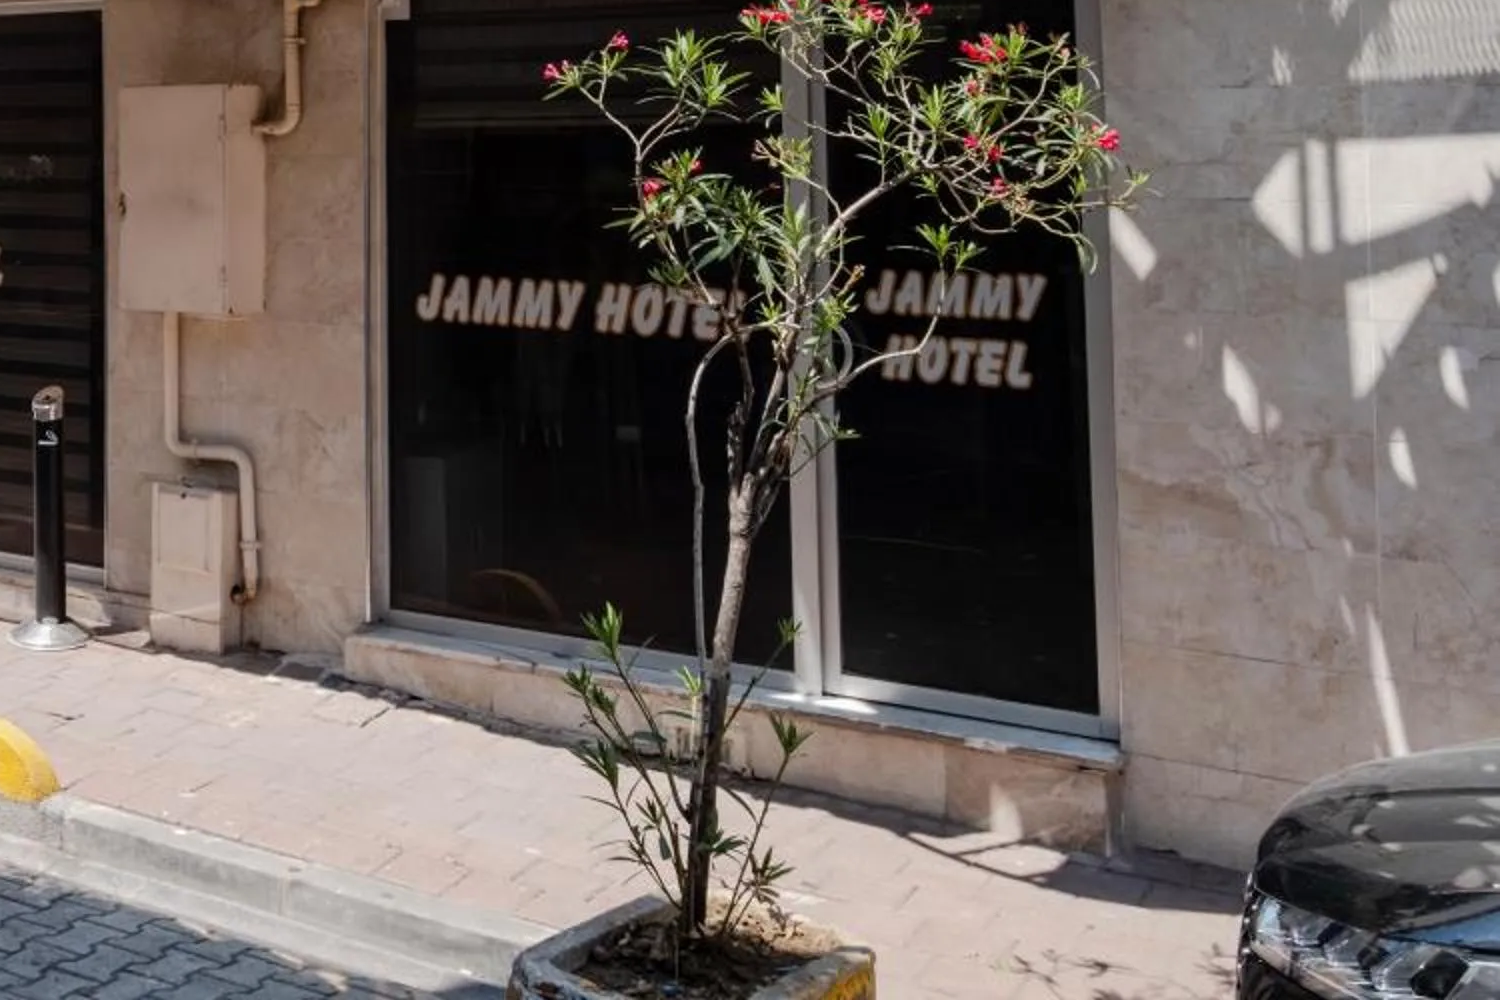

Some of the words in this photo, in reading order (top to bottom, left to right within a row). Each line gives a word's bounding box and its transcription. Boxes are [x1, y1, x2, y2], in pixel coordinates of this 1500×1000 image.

[416, 273, 586, 331] JAMMY
[865, 268, 1048, 322] JAMMY
[880, 333, 1034, 389] HOTEL
